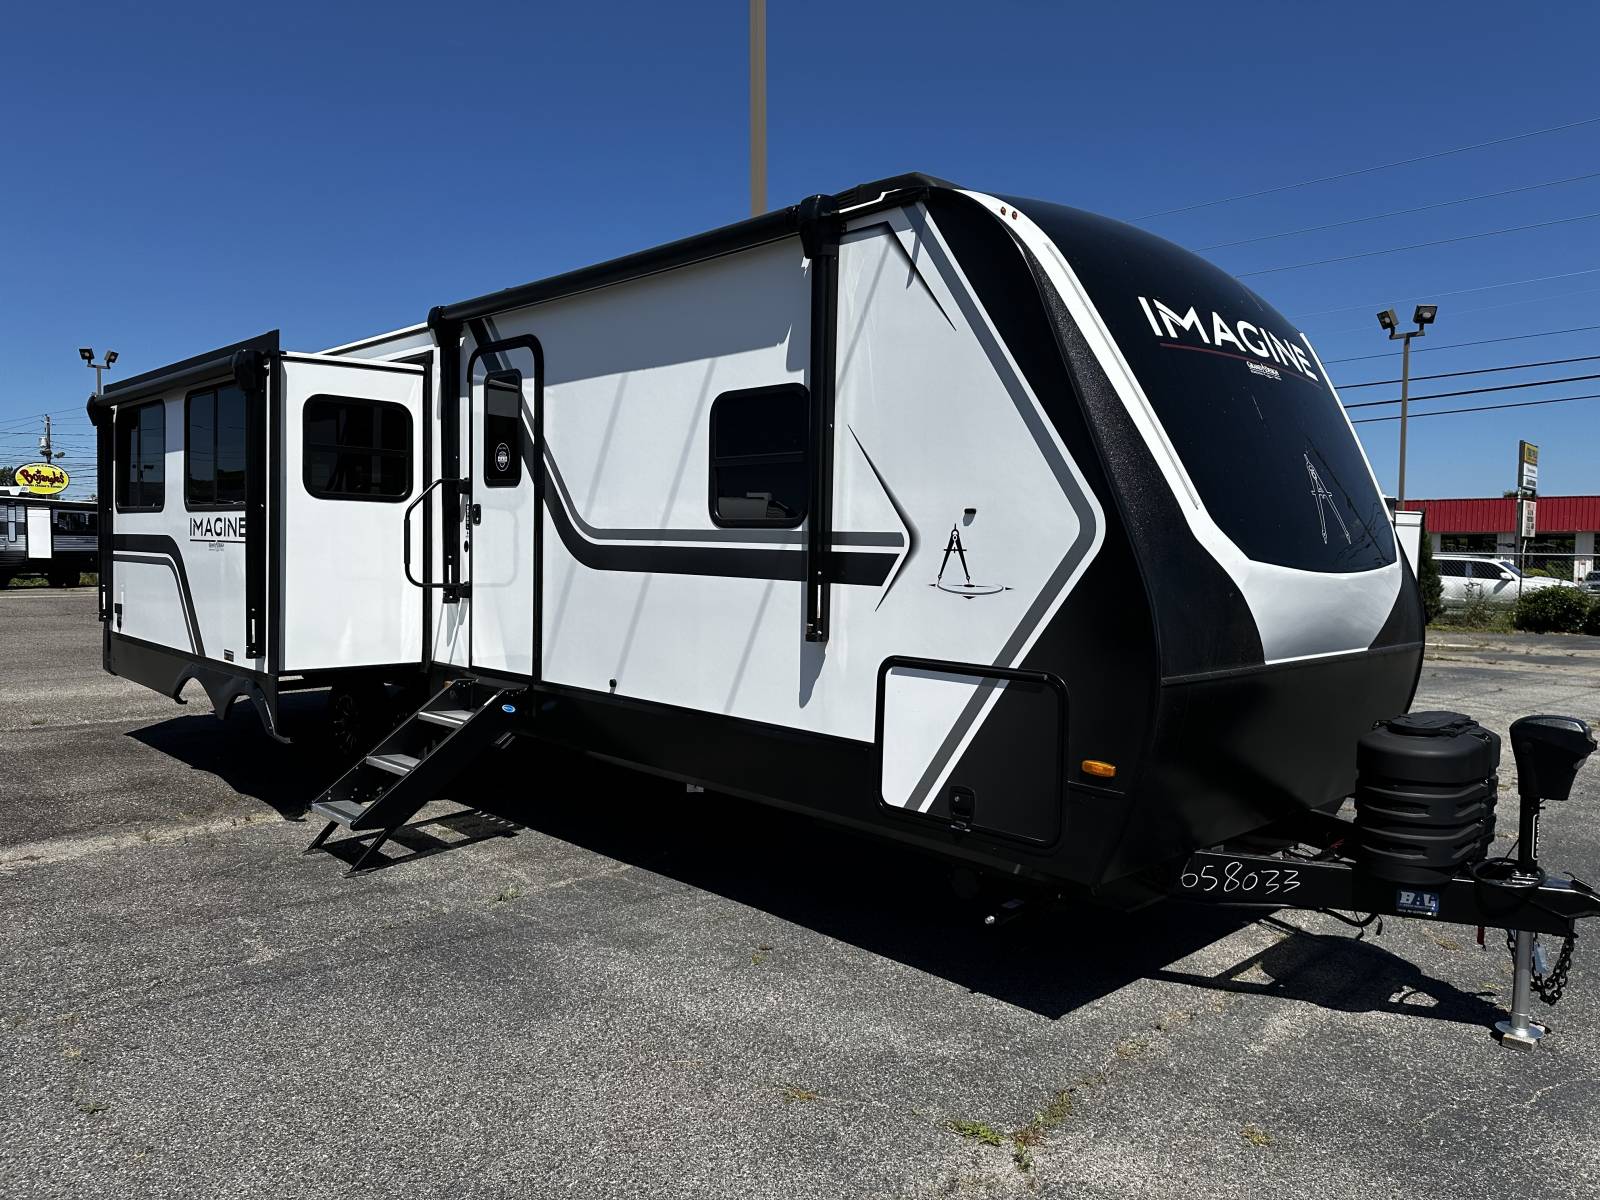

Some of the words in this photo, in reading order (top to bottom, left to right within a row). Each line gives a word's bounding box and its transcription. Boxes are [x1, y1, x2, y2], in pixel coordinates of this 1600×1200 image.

[1137, 296, 1319, 382] IMAGINE
[190, 517, 246, 537] IMAGINE
[1180, 858, 1301, 895] 658033
